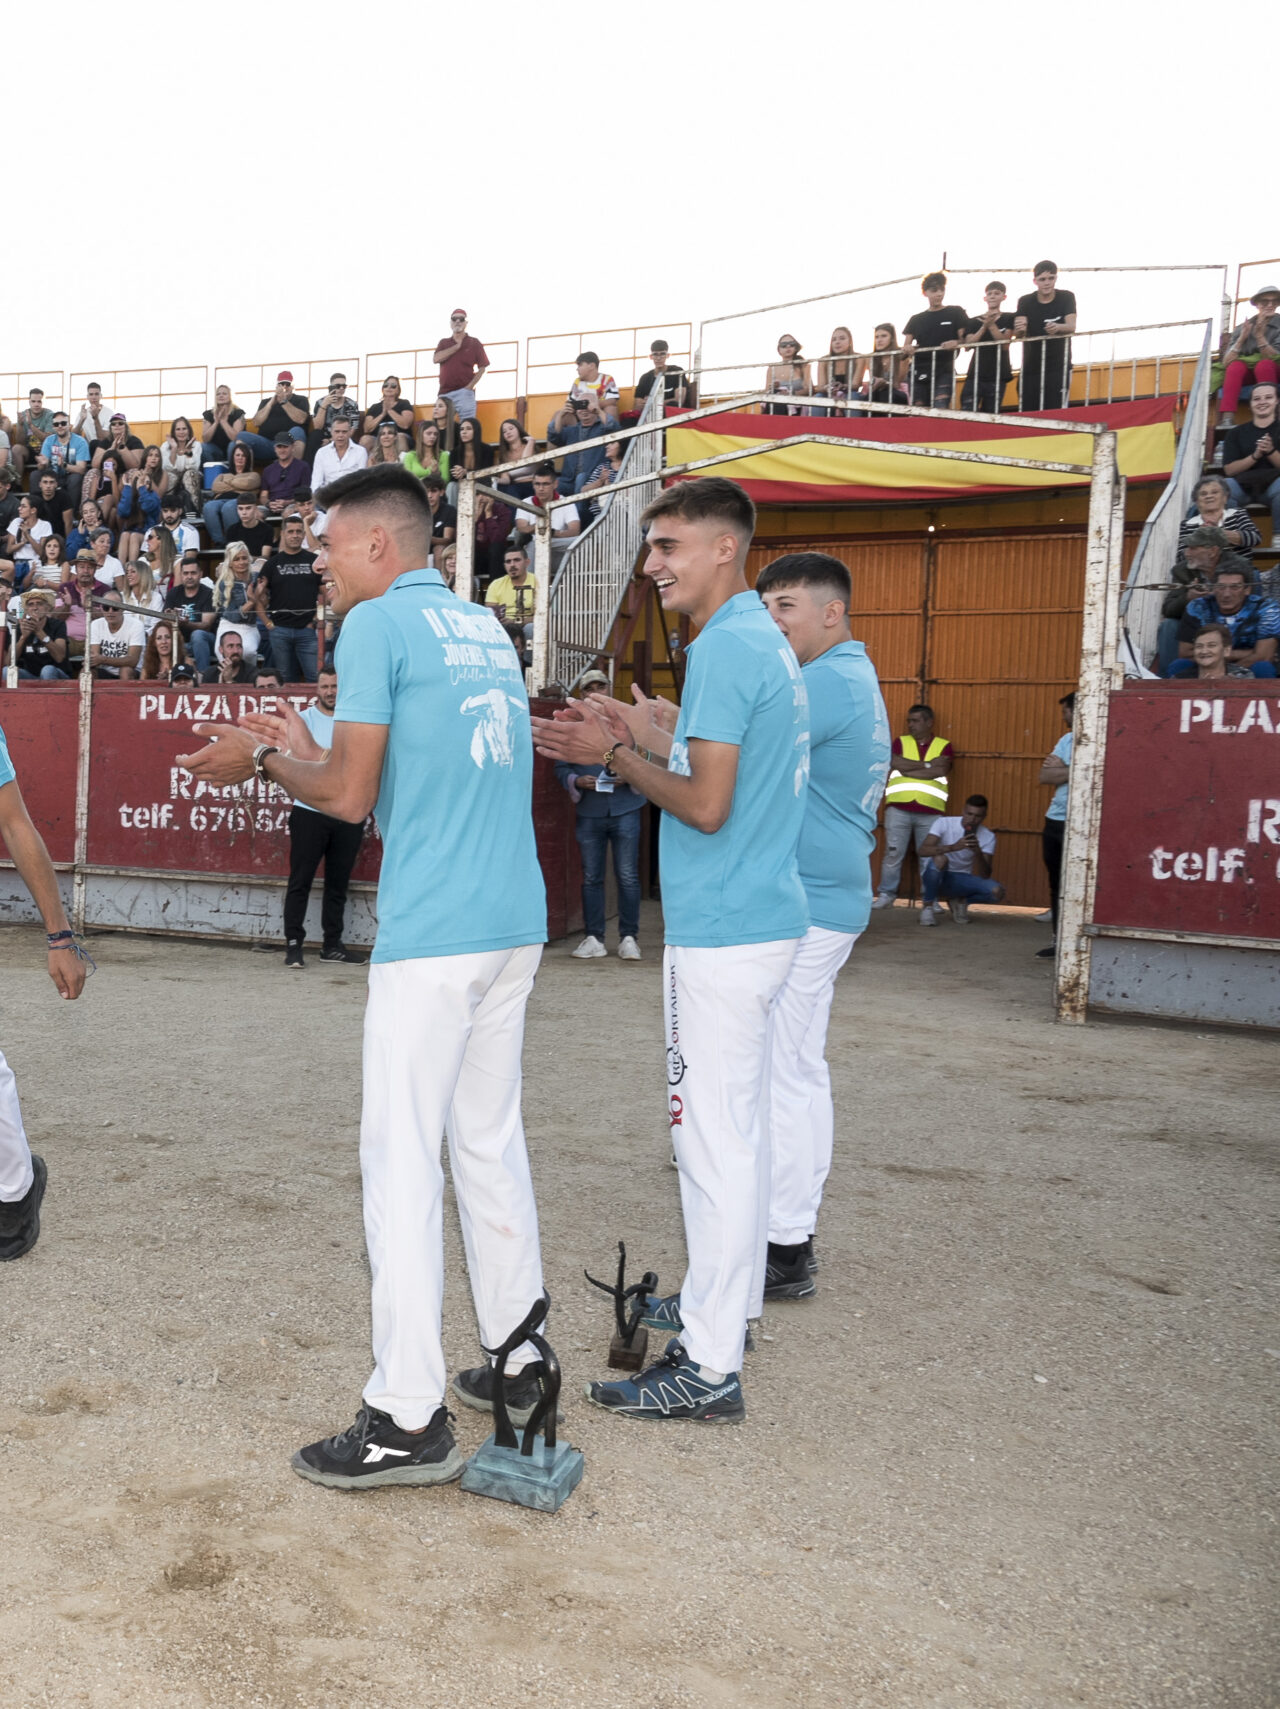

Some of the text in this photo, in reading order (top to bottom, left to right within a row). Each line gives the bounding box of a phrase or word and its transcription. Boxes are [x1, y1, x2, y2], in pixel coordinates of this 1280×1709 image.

[140, 694, 232, 720] PLAZA
[1179, 699, 1280, 734] PLA
[119, 802, 180, 830] telf.
[190, 806, 245, 833] 676
